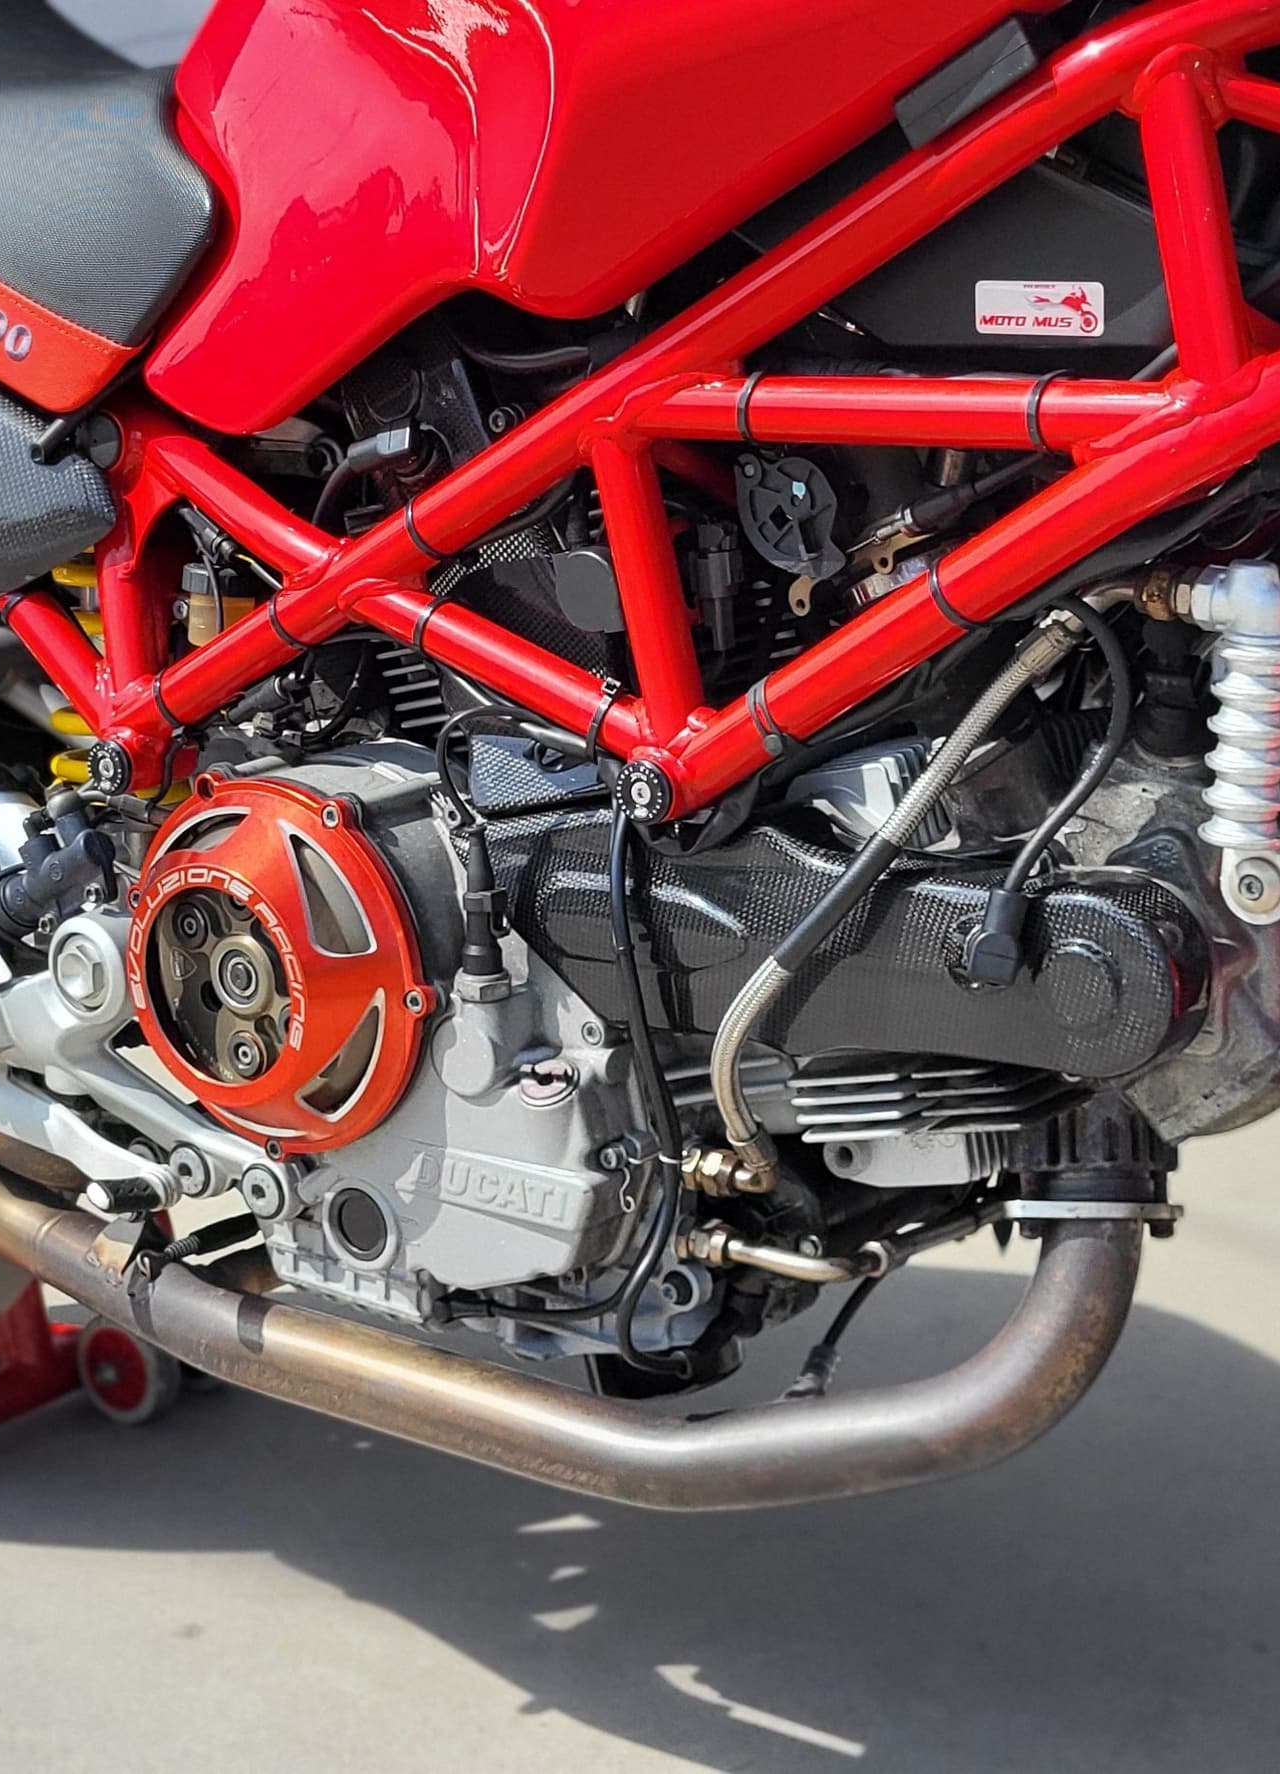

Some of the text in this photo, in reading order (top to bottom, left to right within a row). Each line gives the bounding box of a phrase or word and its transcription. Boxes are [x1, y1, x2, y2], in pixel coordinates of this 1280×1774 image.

[979, 315, 1074, 328] MOTO MUS
[416, 1151, 572, 1224] DUCATI
